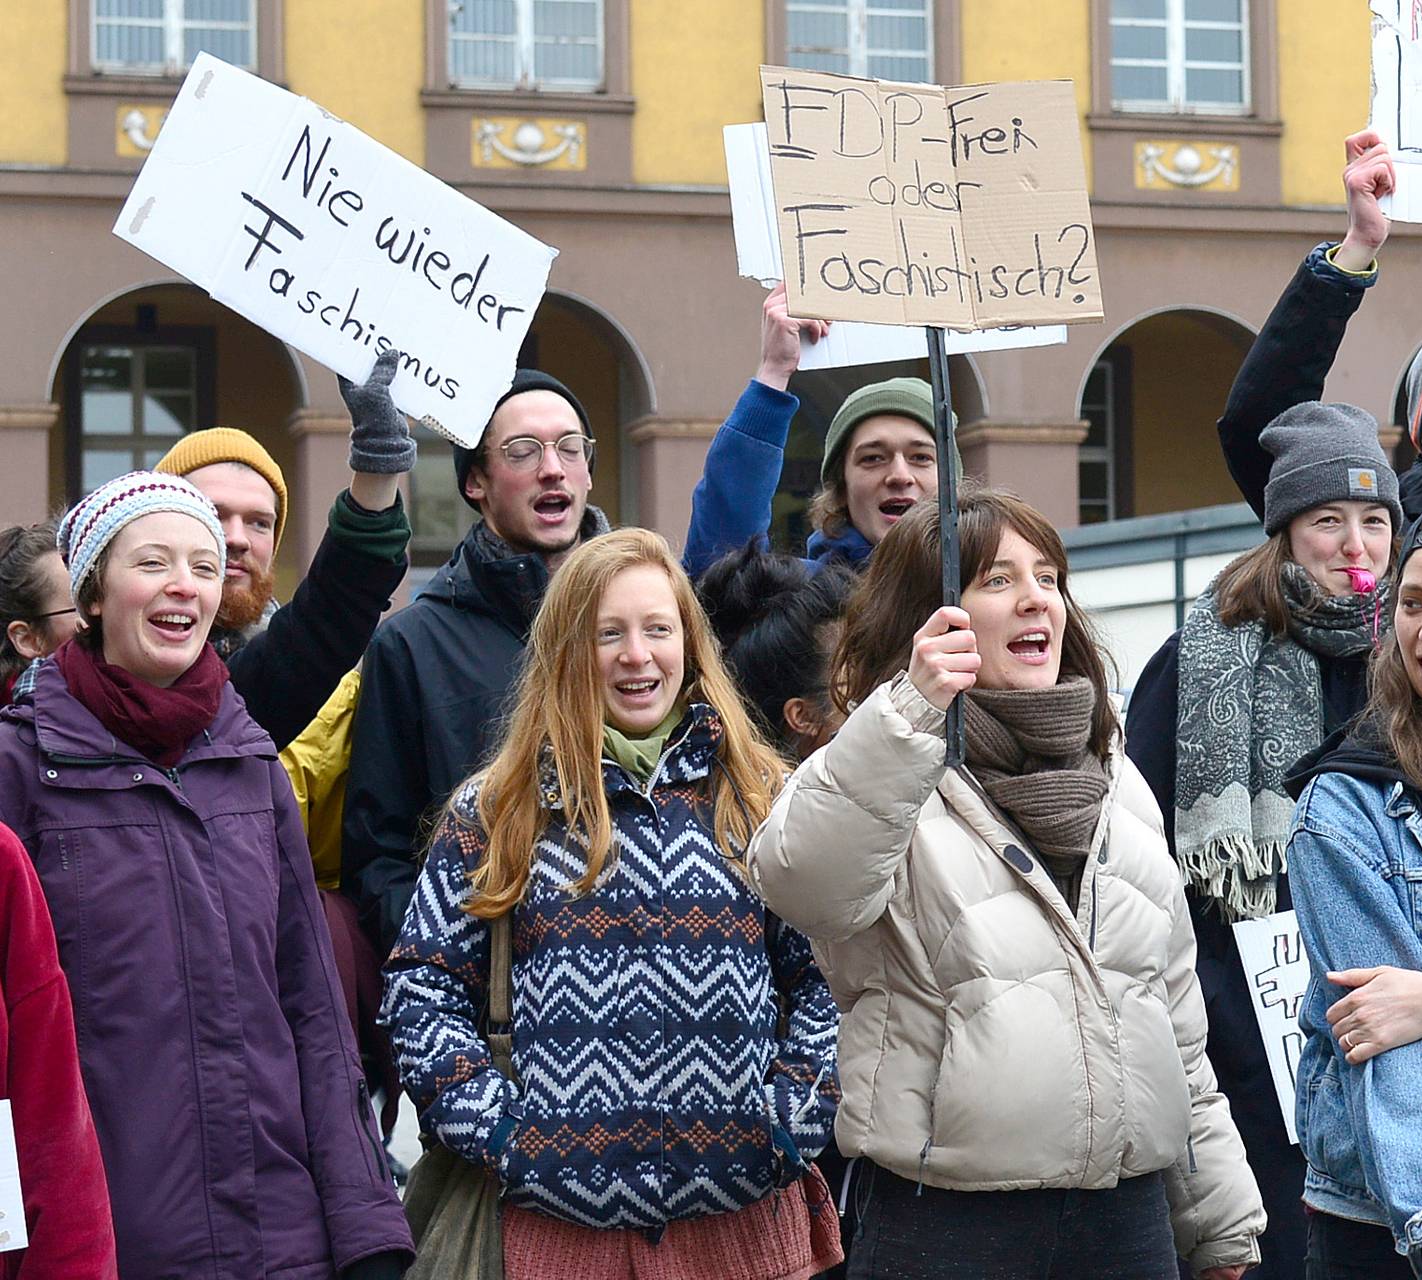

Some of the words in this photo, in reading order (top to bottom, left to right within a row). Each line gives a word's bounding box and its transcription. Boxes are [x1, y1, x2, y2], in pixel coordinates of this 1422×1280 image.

[766, 79, 1040, 167] FDP-Frei
[282, 124, 364, 227] Nie
[375, 215, 525, 331] wieder
[867, 159, 983, 212] oder
[240, 191, 461, 400] Faschismus
[782, 204, 1093, 305] Faschistisch?
